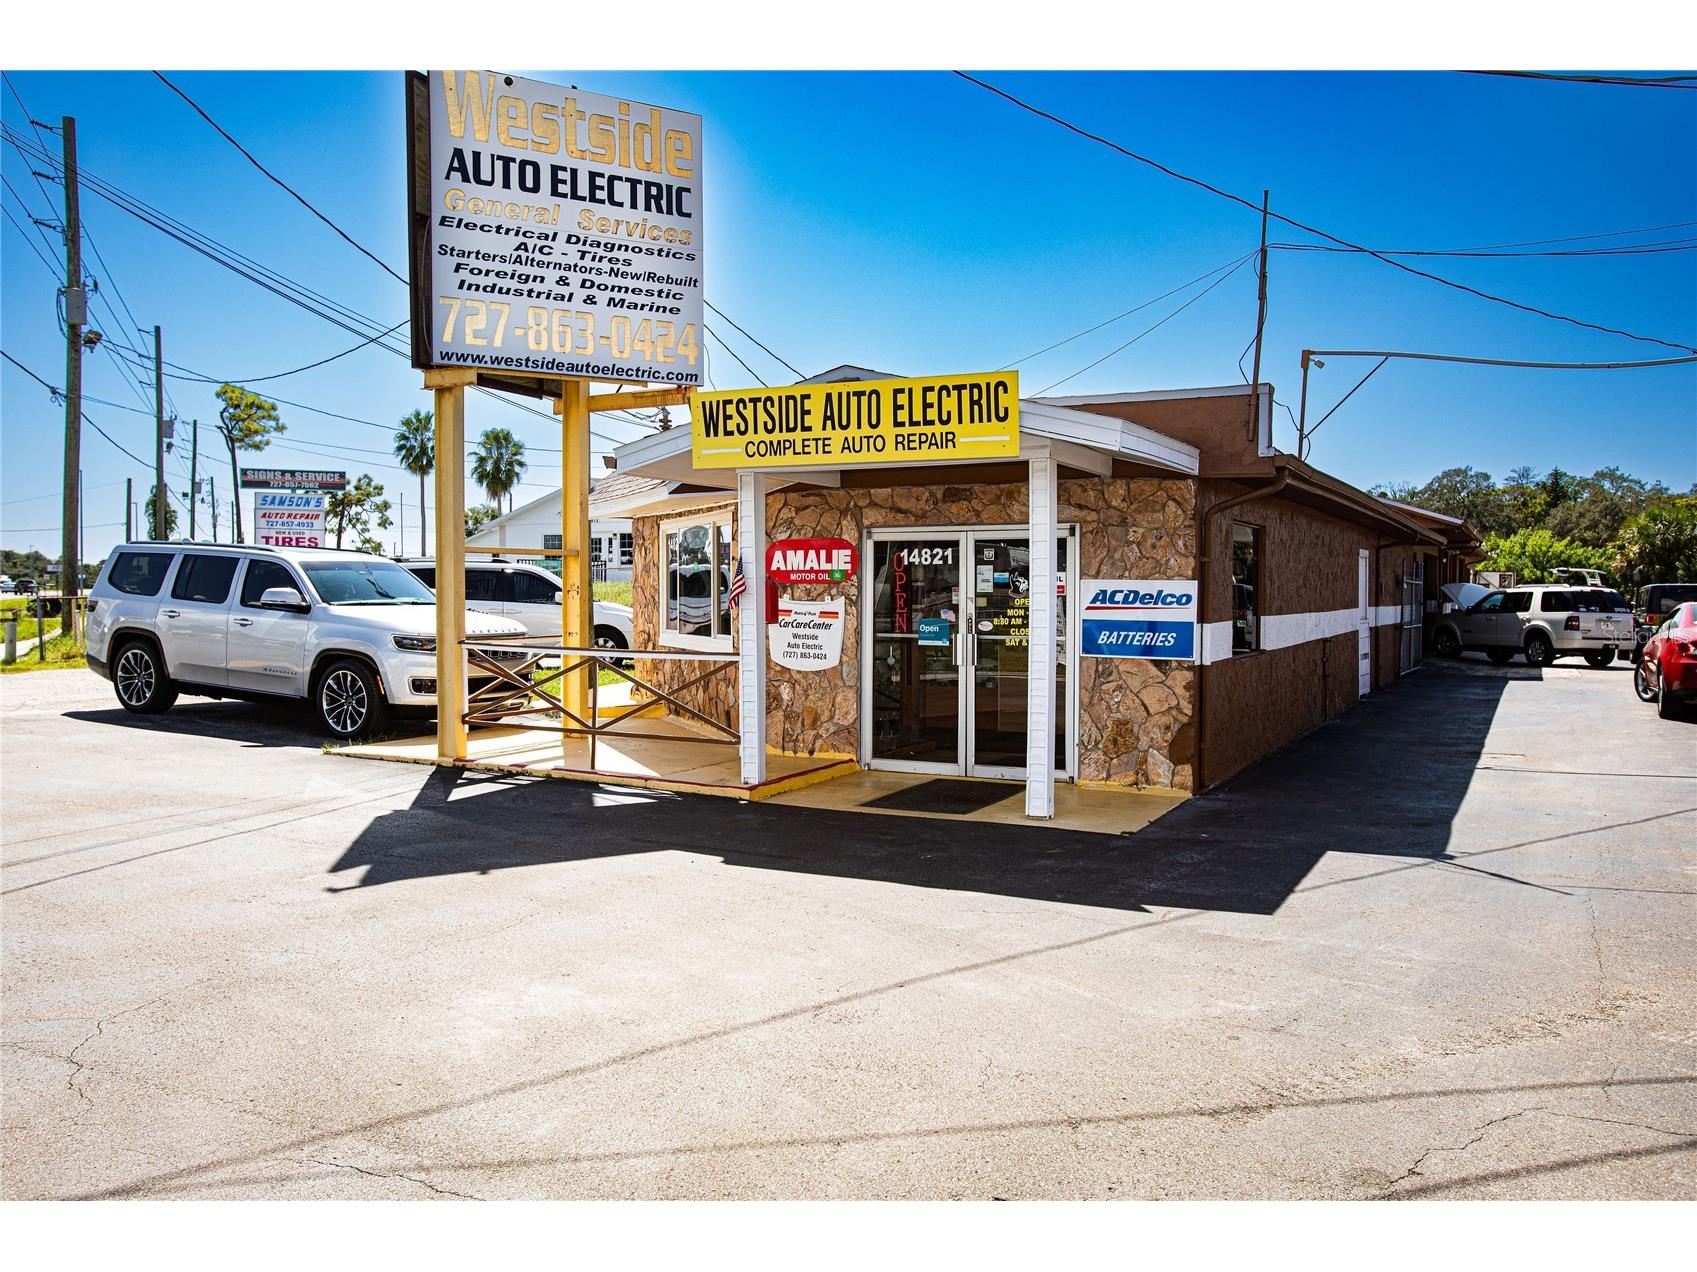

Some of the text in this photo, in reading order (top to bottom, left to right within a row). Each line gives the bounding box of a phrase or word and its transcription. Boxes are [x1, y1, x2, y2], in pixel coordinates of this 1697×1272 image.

[442, 70, 692, 179] Westside
[444, 147, 692, 218] AUTO ELECTRIC
[444, 188, 693, 246] General Services
[438, 215, 697, 261] Electrical Diagnostics
[513, 241, 554, 256] A/C
[577, 250, 633, 267] Tires
[453, 262, 685, 301] Foreign & Domestic
[457, 279, 681, 315] Industrial & Marine
[440, 296, 699, 366] 727-863-0424
[439, 351, 699, 382] www.westsideautoelectric.com
[701, 380, 1009, 438] WESTSIDE AUTO ELECTRIC
[745, 431, 957, 458] COMPLETE AUTO REPAIR
[246, 470, 341, 482] SIGNS & SERVICE
[260, 495, 323, 508] SAMSON'S
[260, 512, 321, 521] AUTO REPAIR
[266, 520, 314, 528] 727-857-4933
[261, 536, 319, 547] TIRES
[770, 549, 852, 571] AMALIE
[900, 548, 952, 565] 14821
[790, 573, 831, 581] MOTOR OIL
[1014, 598, 1030, 606] OPE
[1089, 589, 1193, 606] ACDelco
[791, 632, 819, 641] Westside
[919, 624, 939, 633] Open
[1010, 628, 1030, 636] CLOS
[801, 642, 823, 651] Electric
[1097, 630, 1177, 646] BATTERIES
[782, 651, 827, 661] (727) 863-0424
